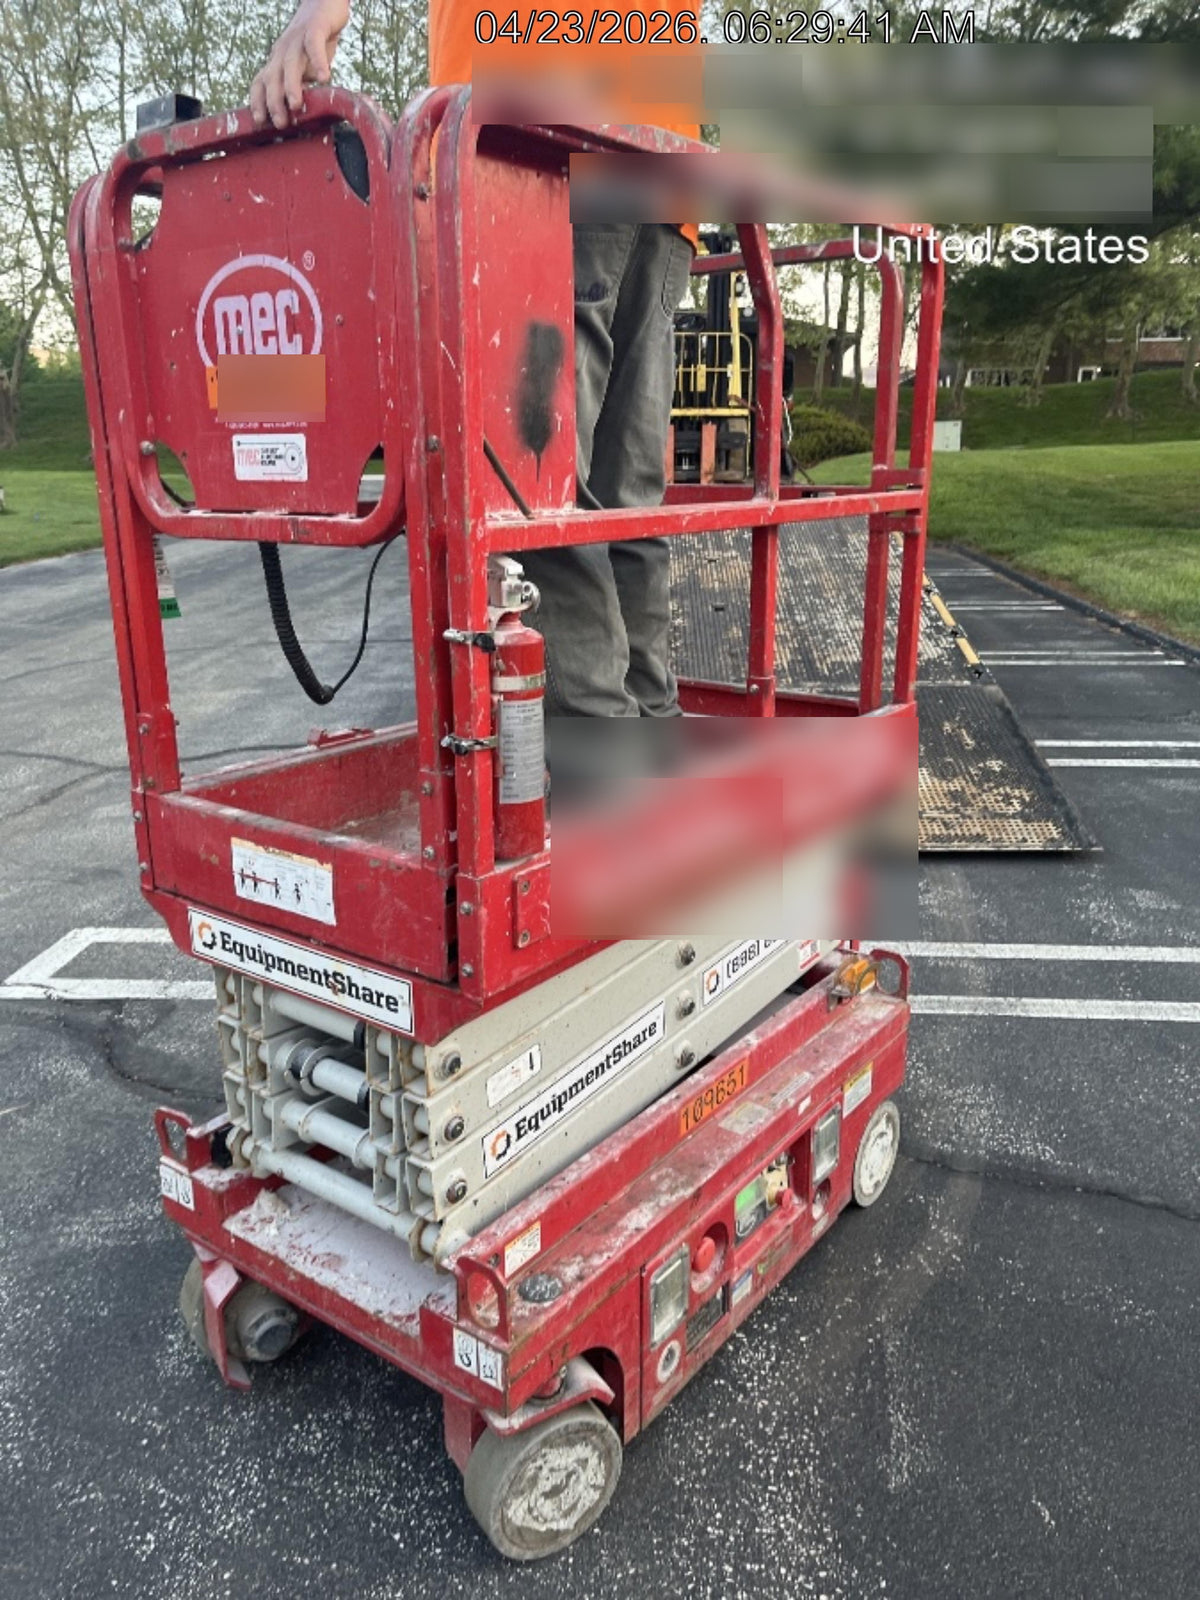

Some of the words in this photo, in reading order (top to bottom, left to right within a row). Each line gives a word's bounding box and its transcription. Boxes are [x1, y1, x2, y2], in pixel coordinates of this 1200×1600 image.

[219, 931, 399, 1014] EquipmentShare
[515, 1021, 657, 1142] EquipmentShare
[682, 1065, 744, 1130] 109651
